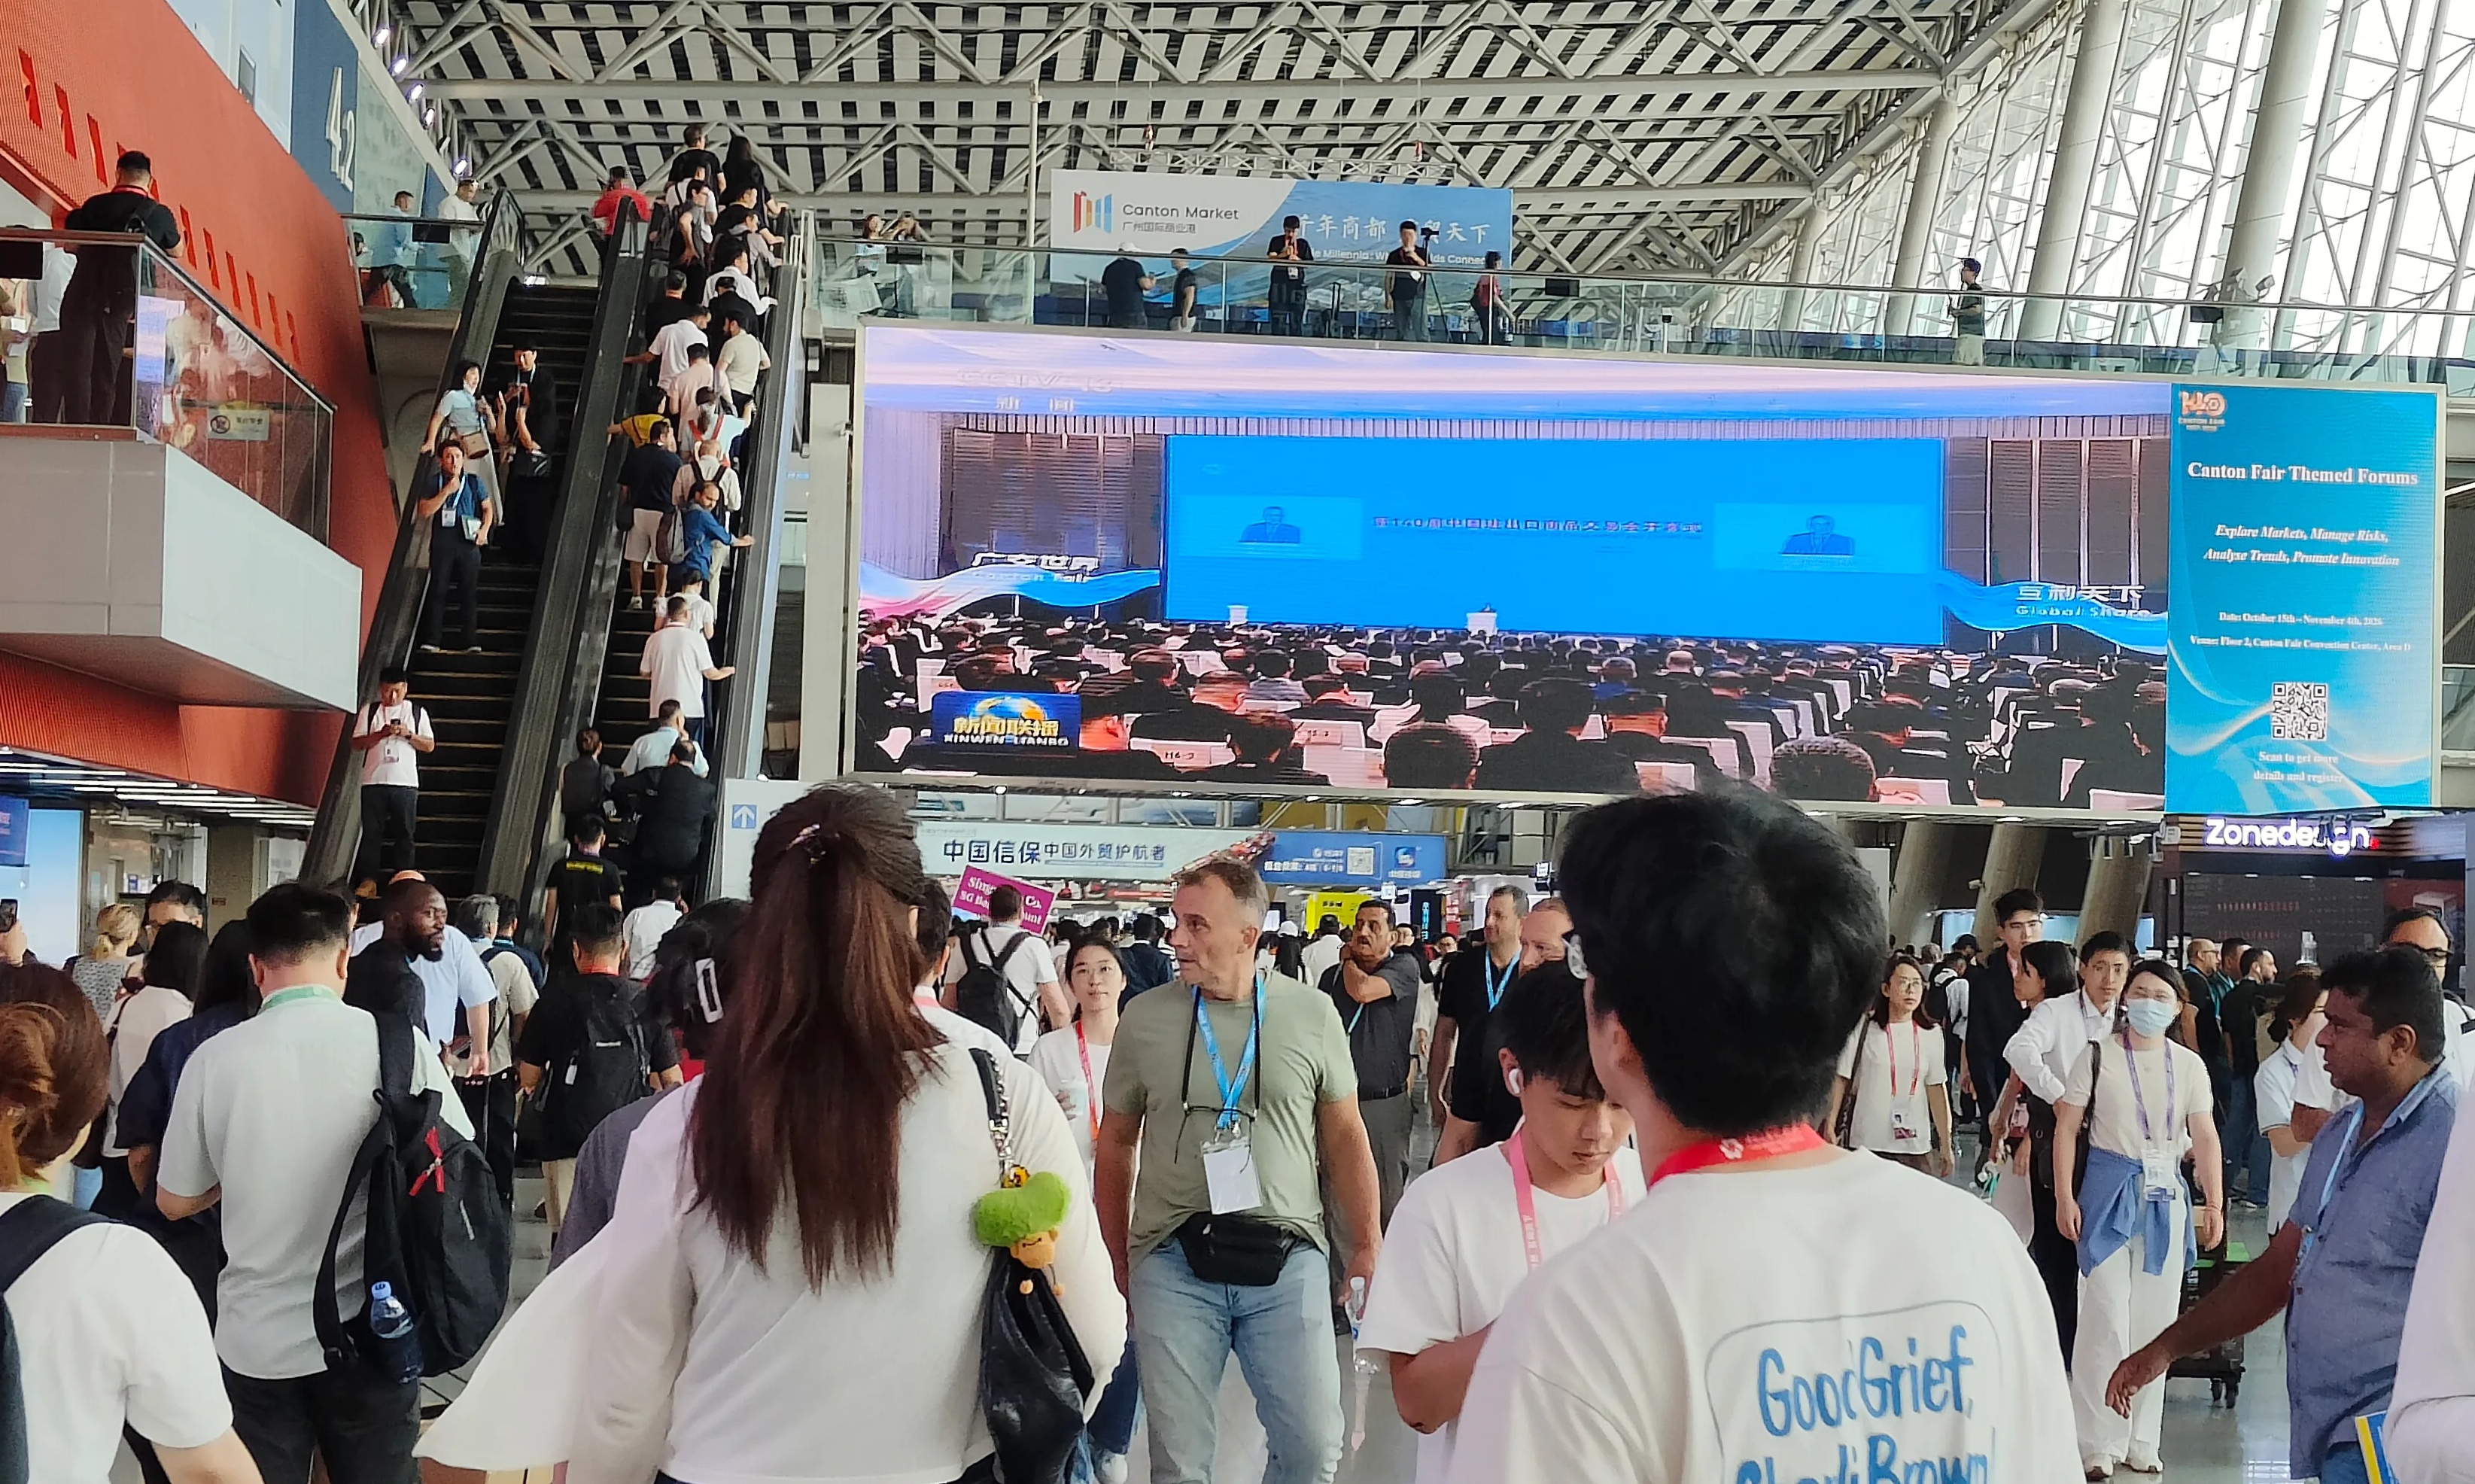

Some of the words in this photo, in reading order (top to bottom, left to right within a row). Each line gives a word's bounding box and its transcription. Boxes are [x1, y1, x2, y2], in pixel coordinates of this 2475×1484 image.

[1123, 204, 1179, 217] Canton
[1185, 206, 1239, 220] Market
[2188, 461, 2247, 479] Canton
[2250, 464, 2286, 481] Fair
[2288, 465, 2354, 484] Themed
[2357, 468, 2419, 485] Forums
[2215, 525, 2258, 540] Explore
[2261, 525, 2308, 541] Markets,
[2310, 528, 2355, 543] Manage
[2357, 529, 2389, 543] Risks,
[2203, 548, 2248, 564] Analyse
[2249, 549, 2290, 564] Trends,
[2292, 551, 2339, 565] Promote
[2341, 552, 2401, 566] Innovation
[953, 717, 1060, 737] 新闻联播
[2258, 750, 2283, 763] Scan
[2285, 752, 2294, 763] to
[2296, 753, 2311, 766] get
[2312, 755, 2339, 764] more
[2253, 771, 2284, 782] details
[2285, 771, 2306, 782] and
[2306, 773, 2344, 785] register
[944, 839, 1041, 864] 中国信保
[1044, 842, 1166, 861] 中国外贸护航者
